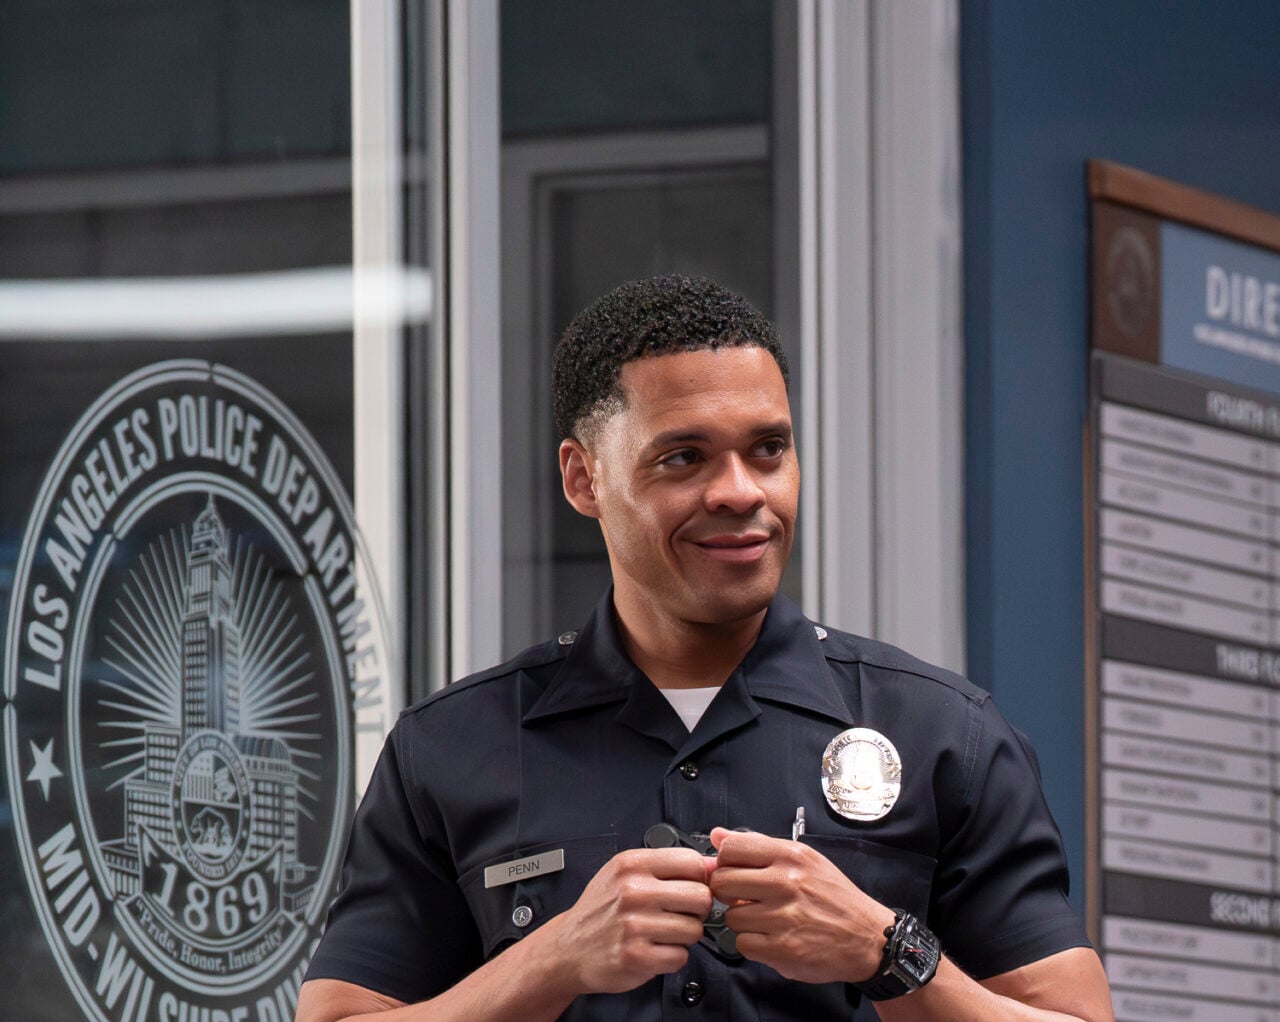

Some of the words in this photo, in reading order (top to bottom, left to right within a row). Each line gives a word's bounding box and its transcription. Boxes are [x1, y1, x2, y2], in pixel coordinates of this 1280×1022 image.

[158, 395, 263, 477] POLICE
[45, 408, 158, 592] ANGELES
[262, 436, 384, 741] DEPARTMENT
[25, 584, 70, 690] LOS
[151, 863, 268, 936] 1869
[508, 860, 540, 876] PENN
[180, 943, 226, 973] Honor,
